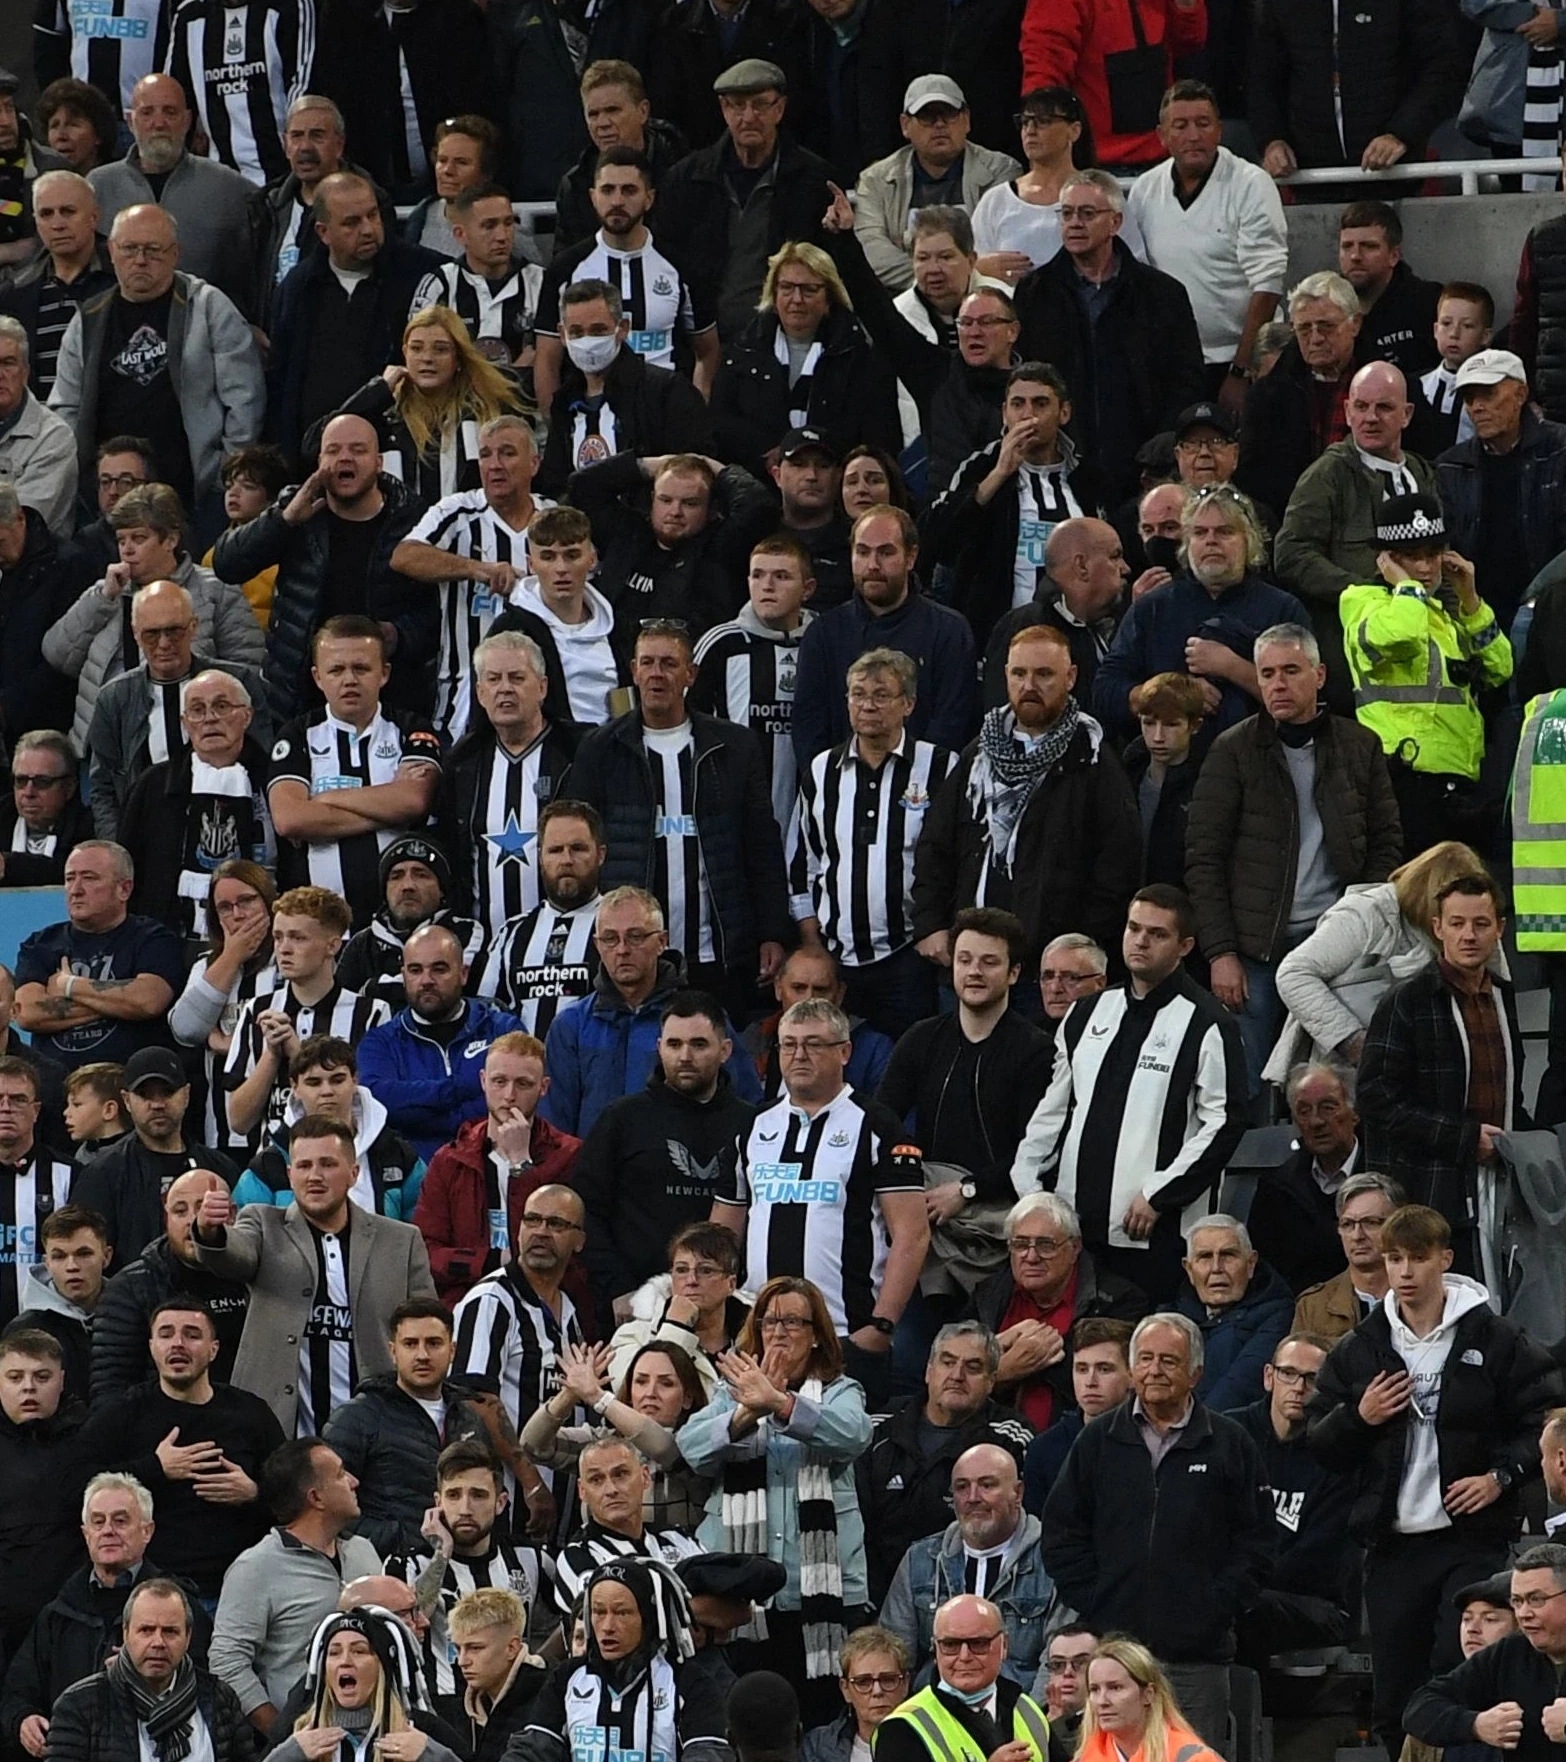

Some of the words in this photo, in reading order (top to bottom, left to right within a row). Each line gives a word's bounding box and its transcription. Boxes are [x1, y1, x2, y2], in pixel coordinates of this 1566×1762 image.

[74, 16, 150, 39] FUN88
[204, 60, 267, 84] northern
[215, 78, 250, 97] rock
[516, 965, 588, 985] northern
[528, 980, 565, 998] rock
[1138, 1061, 1171, 1074] FUN88
[754, 1181, 841, 1205] FUN88
